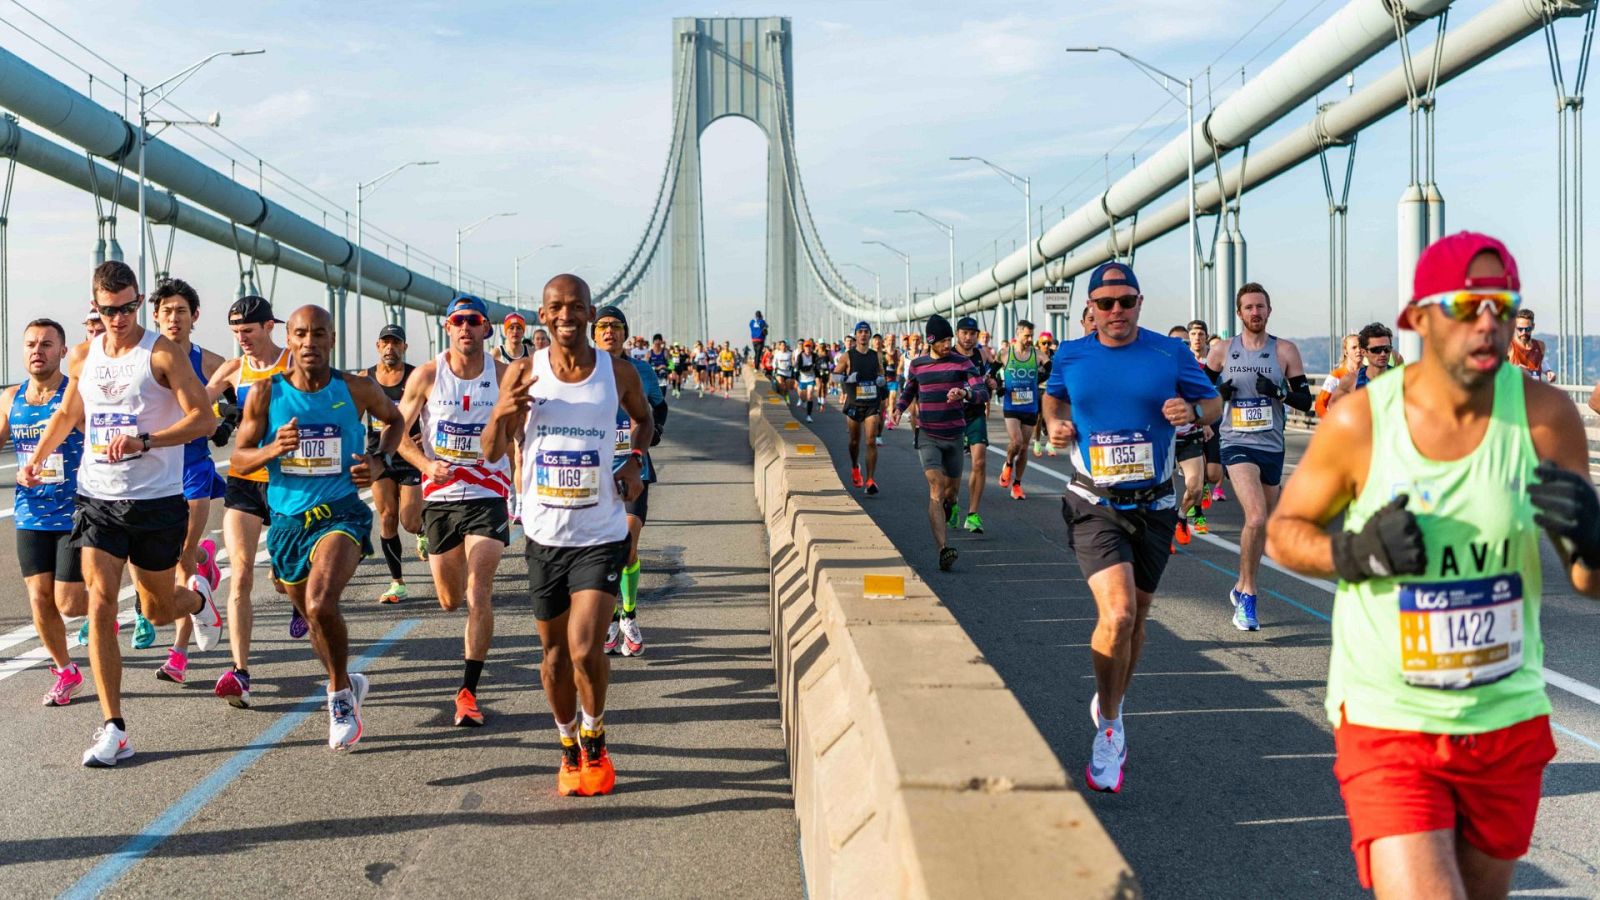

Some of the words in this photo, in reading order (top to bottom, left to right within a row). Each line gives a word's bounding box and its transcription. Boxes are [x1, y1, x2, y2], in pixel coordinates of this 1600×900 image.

[94, 365, 135, 379] SEABASS
[1008, 368, 1036, 379] ROC
[1229, 366, 1272, 374] STASHVILLE
[1246, 409, 1262, 421] 1326
[548, 427, 605, 439] UPPAbaby
[1097, 434, 1112, 444] tcs
[301, 440, 325, 458] 1078
[454, 436, 472, 451] 1134
[543, 453, 559, 465] tcs
[1111, 446, 1136, 465] 1355
[558, 468, 581, 487] 1169
[1415, 588, 1449, 610] tcs
[1448, 611, 1496, 649] 1422
